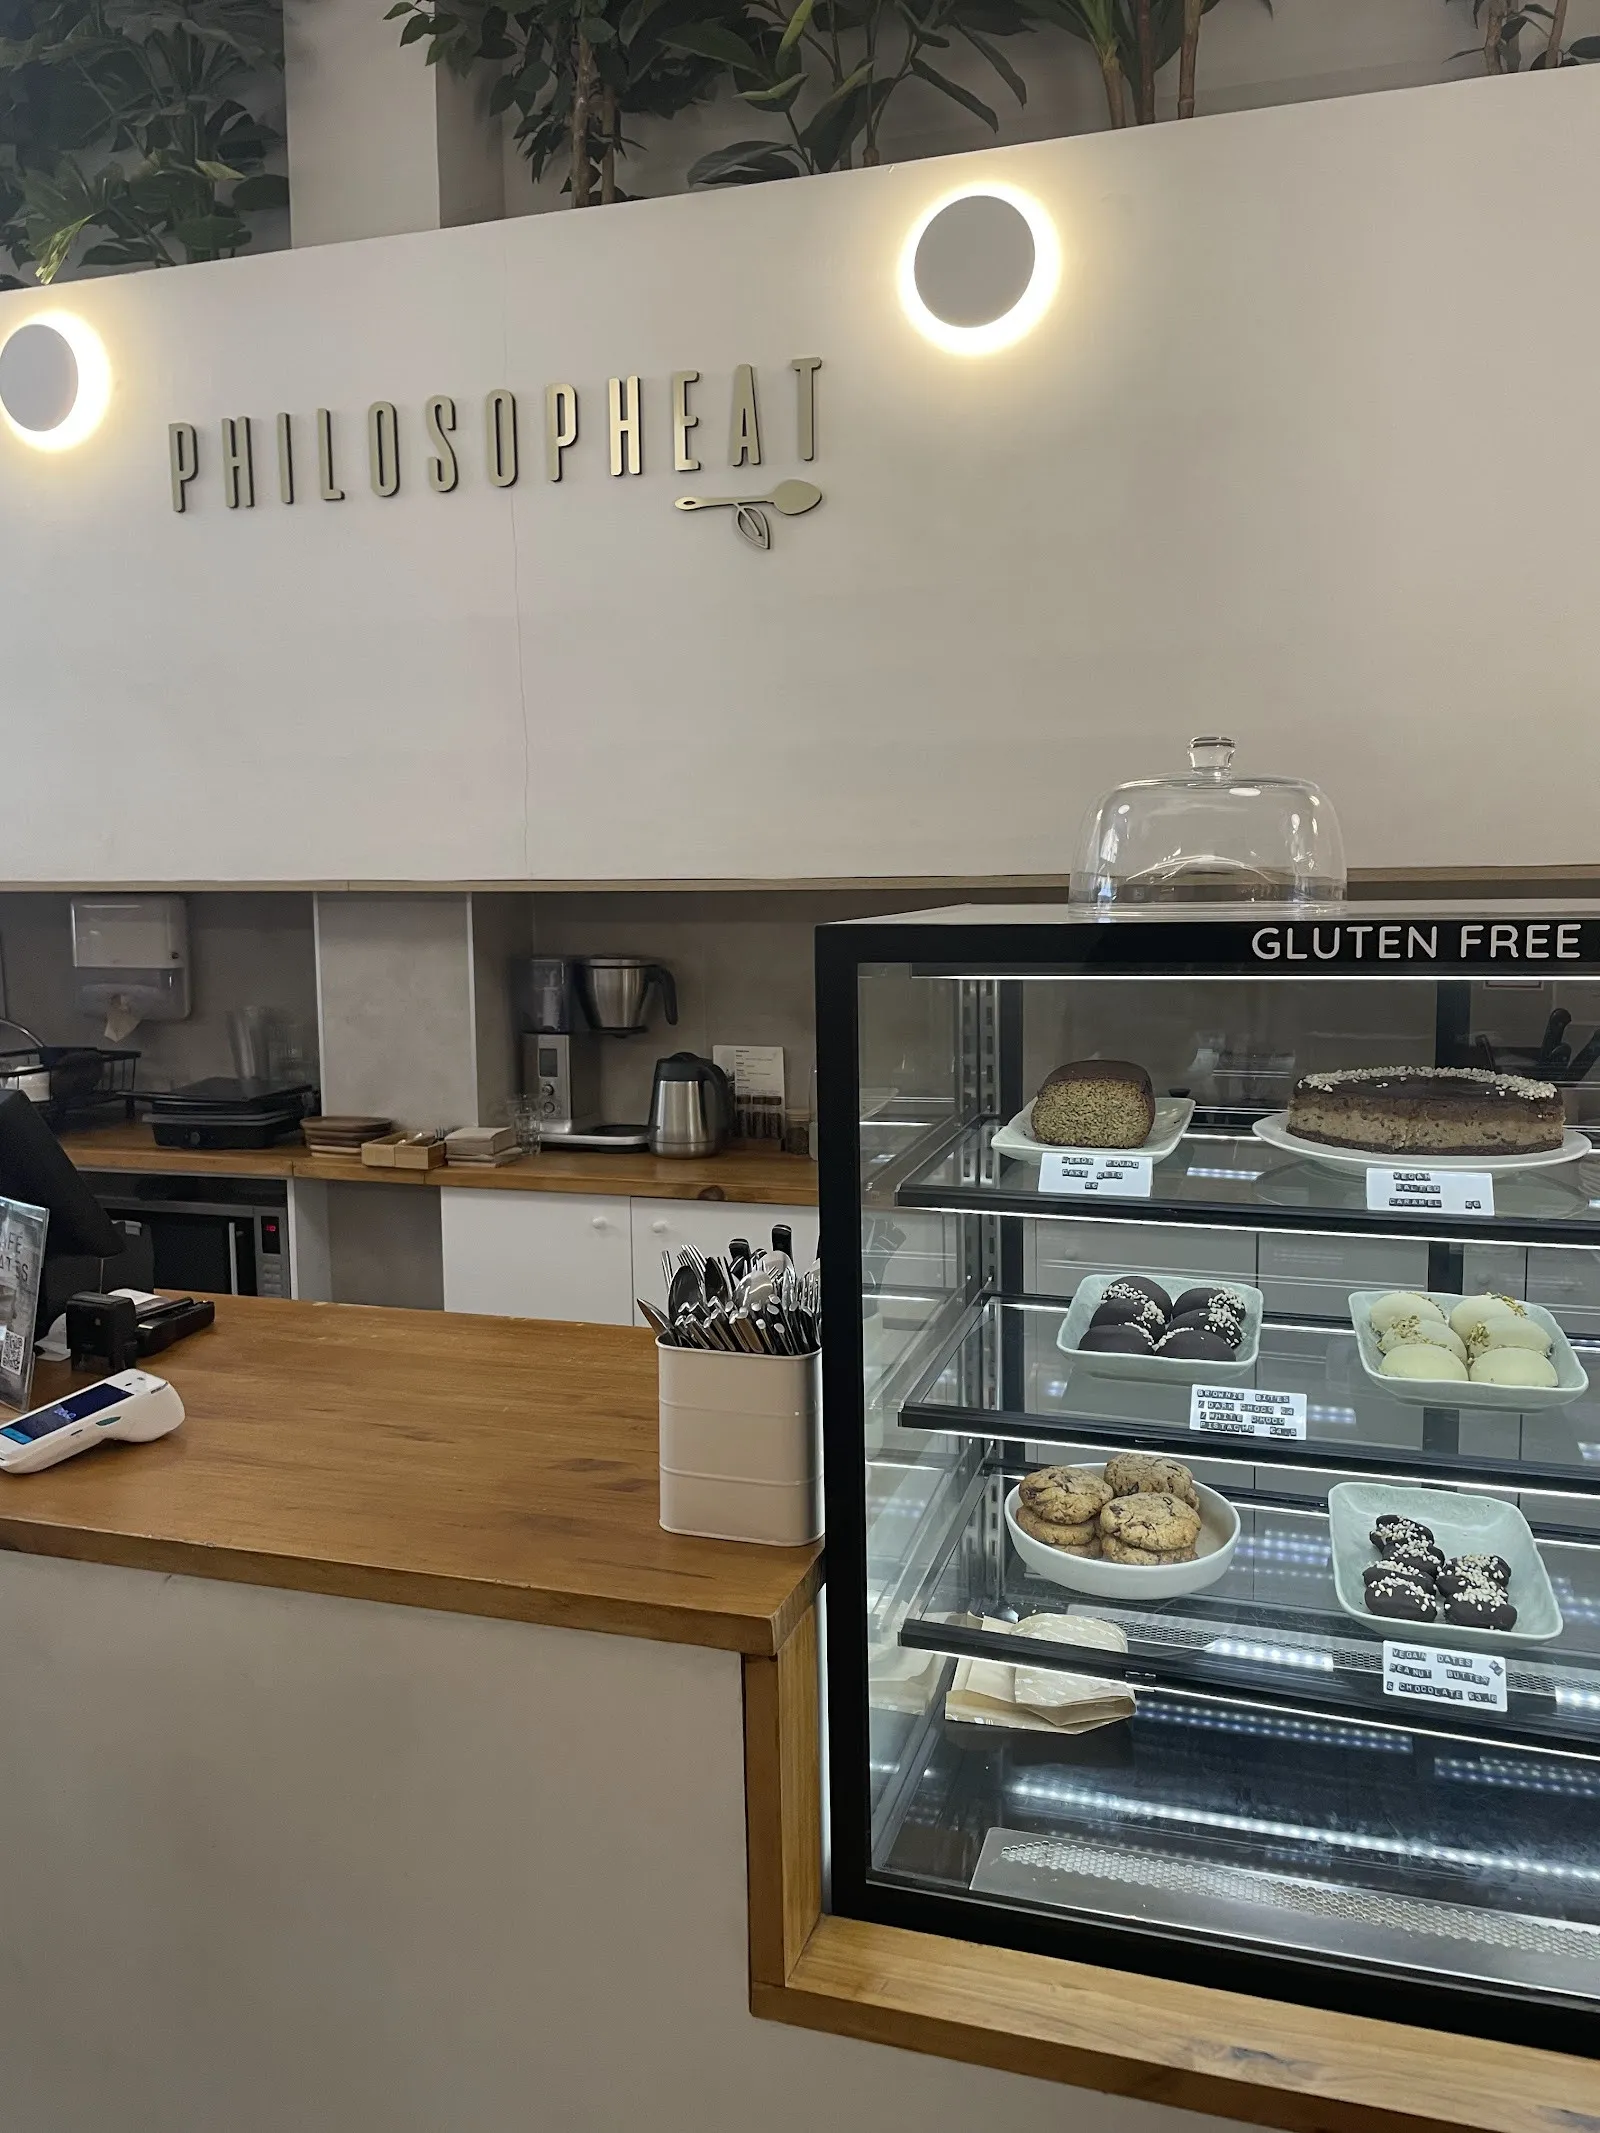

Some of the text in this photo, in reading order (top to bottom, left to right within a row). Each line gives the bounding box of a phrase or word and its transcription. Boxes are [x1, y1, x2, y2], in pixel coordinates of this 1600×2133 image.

[168, 356, 823, 513] PHILOSOPHEAT
[1251, 923, 1582, 960] GLUTEN FREE
[1062, 1169, 1123, 1179] CAKE KETO
[1393, 1172, 1431, 1181] VEGAN
[1396, 1184, 1440, 1193] SALTED
[1389, 1198, 1442, 1208] CARAMEL
[1197, 1389, 1290, 1403] BROWNIE BITES
[1208, 1401, 1234, 1411] DARK
[1240, 1403, 1274, 1414] CHOCO
[1209, 1412, 1243, 1422] WHITE
[1251, 1415, 1285, 1425] CHOCO
[1392, 1648, 1427, 1661] VEGAN
[1437, 1654, 1473, 1668] DATES
[1389, 1663, 1490, 1686] PEANUT BUTTER
[1399, 1682, 1463, 1700] CHOCOLATE
